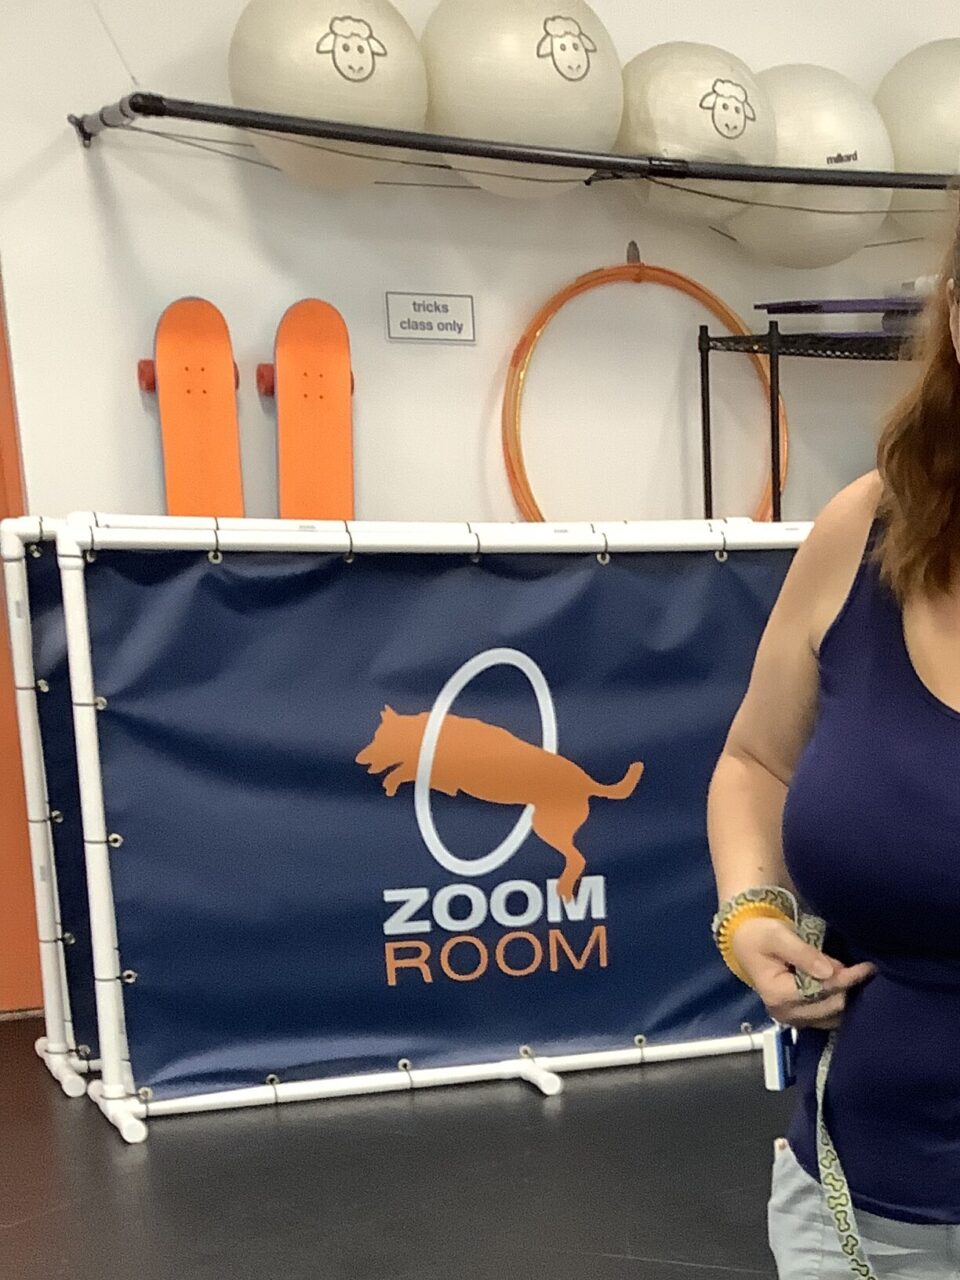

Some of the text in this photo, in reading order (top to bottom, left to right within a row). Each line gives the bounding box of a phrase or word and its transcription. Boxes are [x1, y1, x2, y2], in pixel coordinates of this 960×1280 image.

[399, 318, 463, 334] class only
[412, 301, 449, 313] tricks
[383, 875, 607, 935] ZOOM
[385, 925, 608, 986] ROOM
